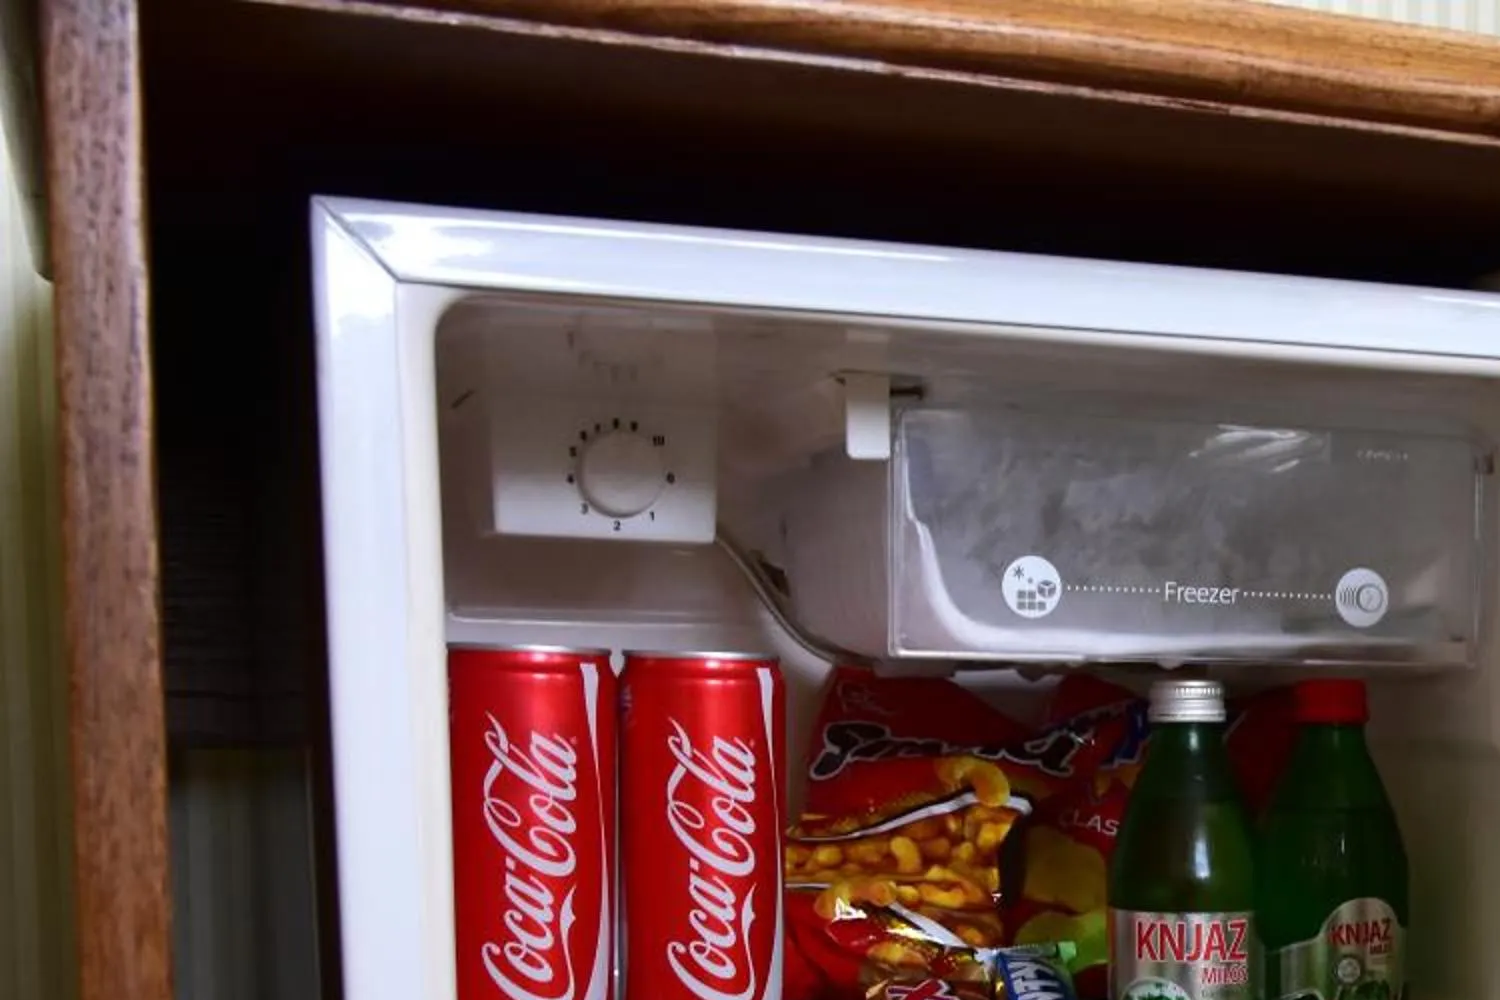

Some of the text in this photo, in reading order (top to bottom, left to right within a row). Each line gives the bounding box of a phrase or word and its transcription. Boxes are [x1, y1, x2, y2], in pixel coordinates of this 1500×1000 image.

[1163, 580, 1240, 607] Freezer
[1136, 918, 1249, 962] KNJAZ
[1329, 918, 1393, 947] KNJAZ
